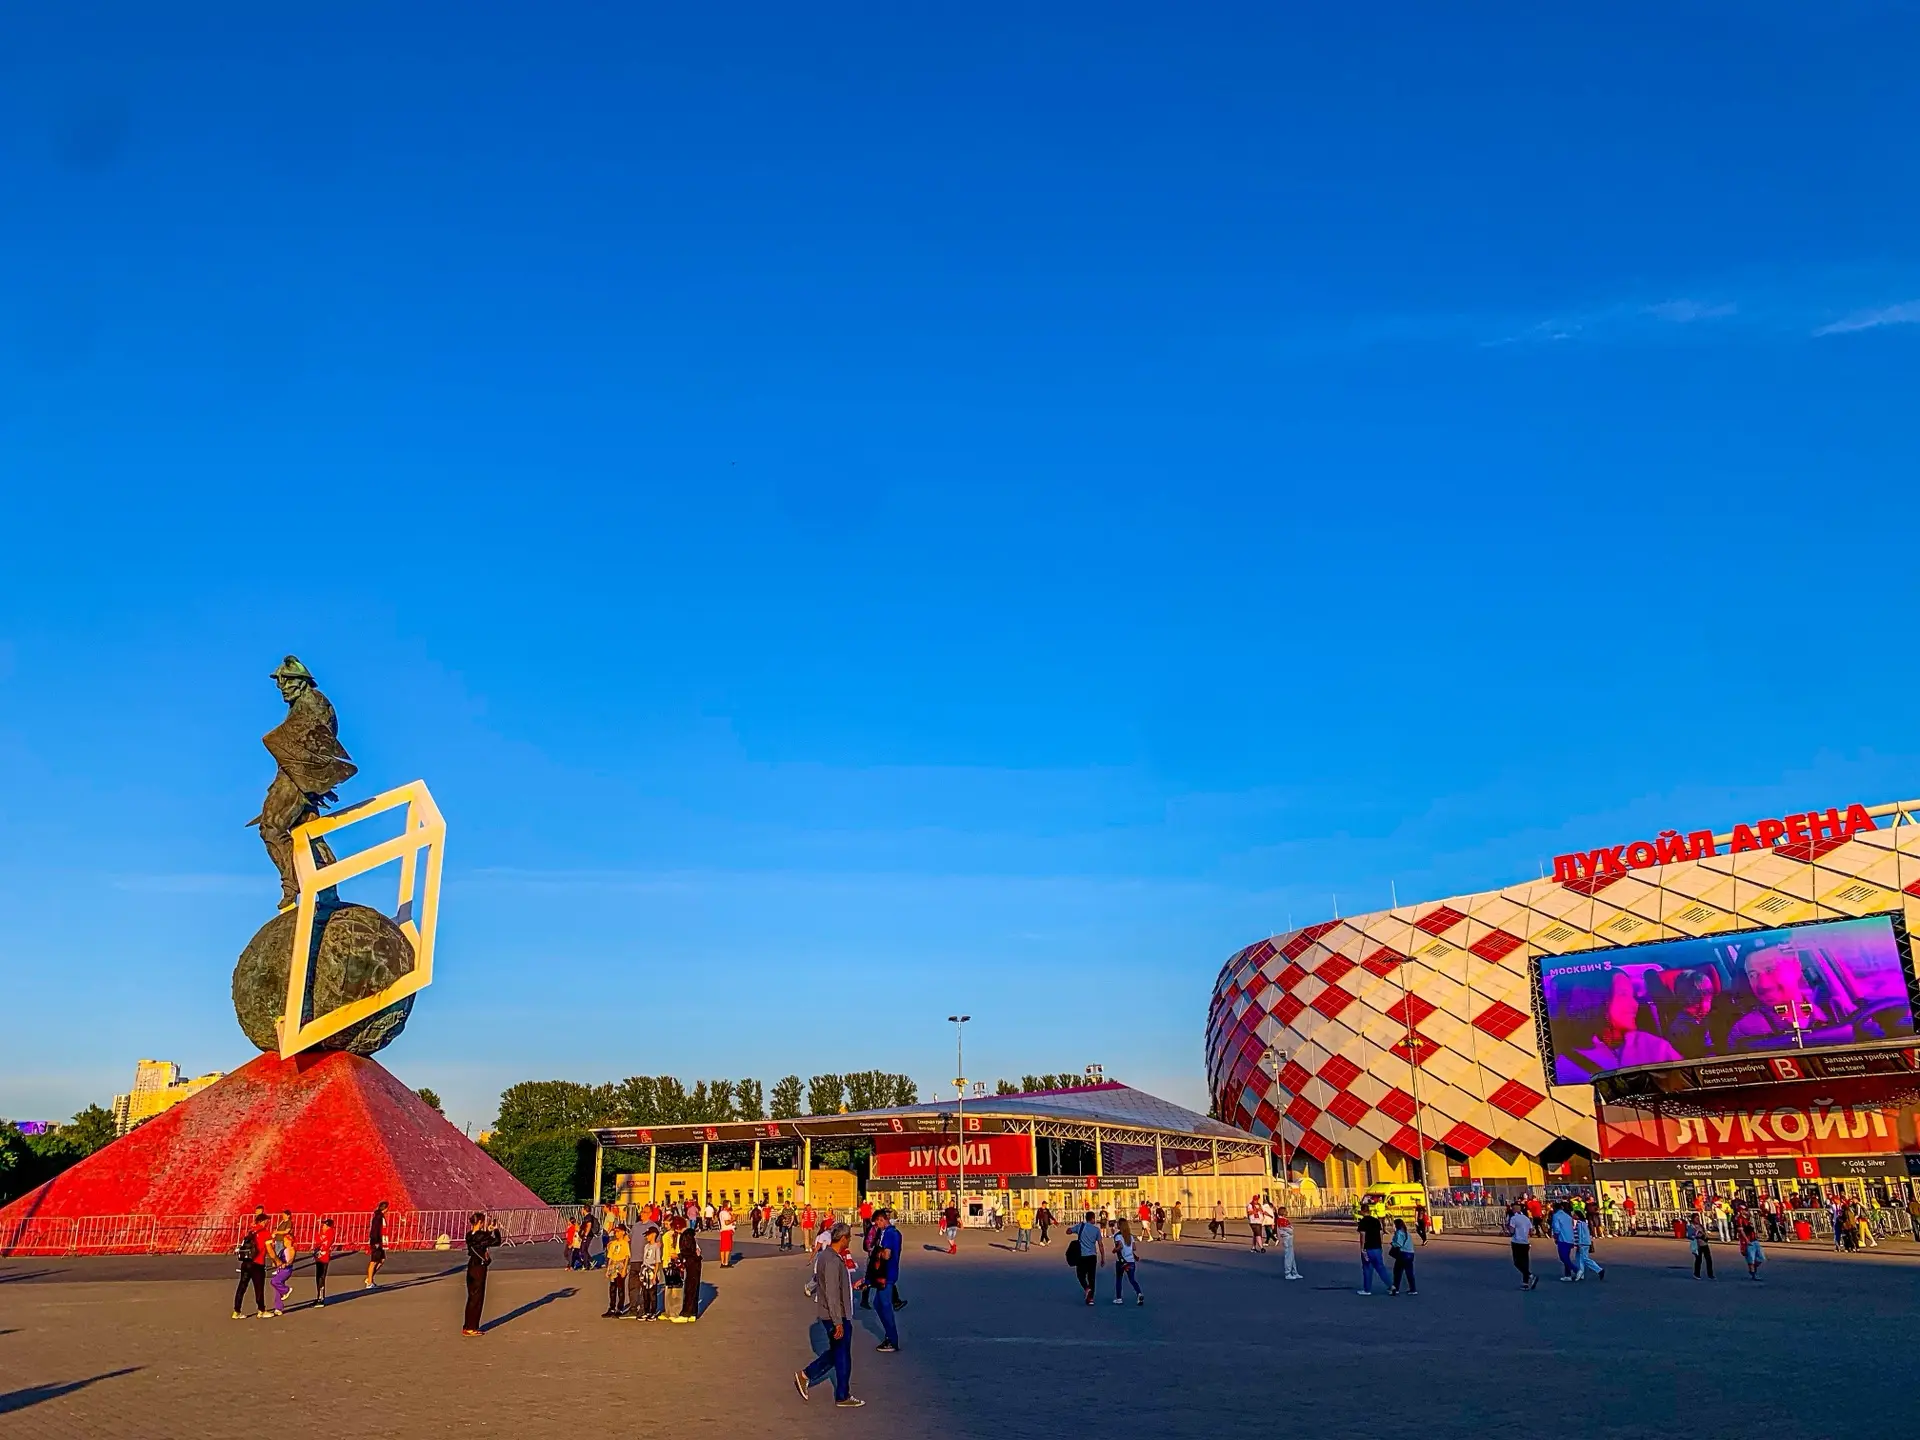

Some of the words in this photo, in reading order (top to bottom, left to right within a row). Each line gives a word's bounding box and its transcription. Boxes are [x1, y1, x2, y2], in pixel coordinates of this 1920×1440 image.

[1552, 829, 1716, 883] ЛУКОЙЛ
[1730, 803, 1878, 854] АРЕНА
[1549, 963, 1602, 976] МОСКВИЧ
[1603, 961, 1612, 971] 3
[1823, 1055, 1863, 1064] Западная
[1864, 1052, 1900, 1062] трибуна
[1700, 1065, 1734, 1075] Северная
[1734, 1064, 1766, 1074] трибуна
[1676, 1097, 1889, 1145] ЛУКОЙЛ
